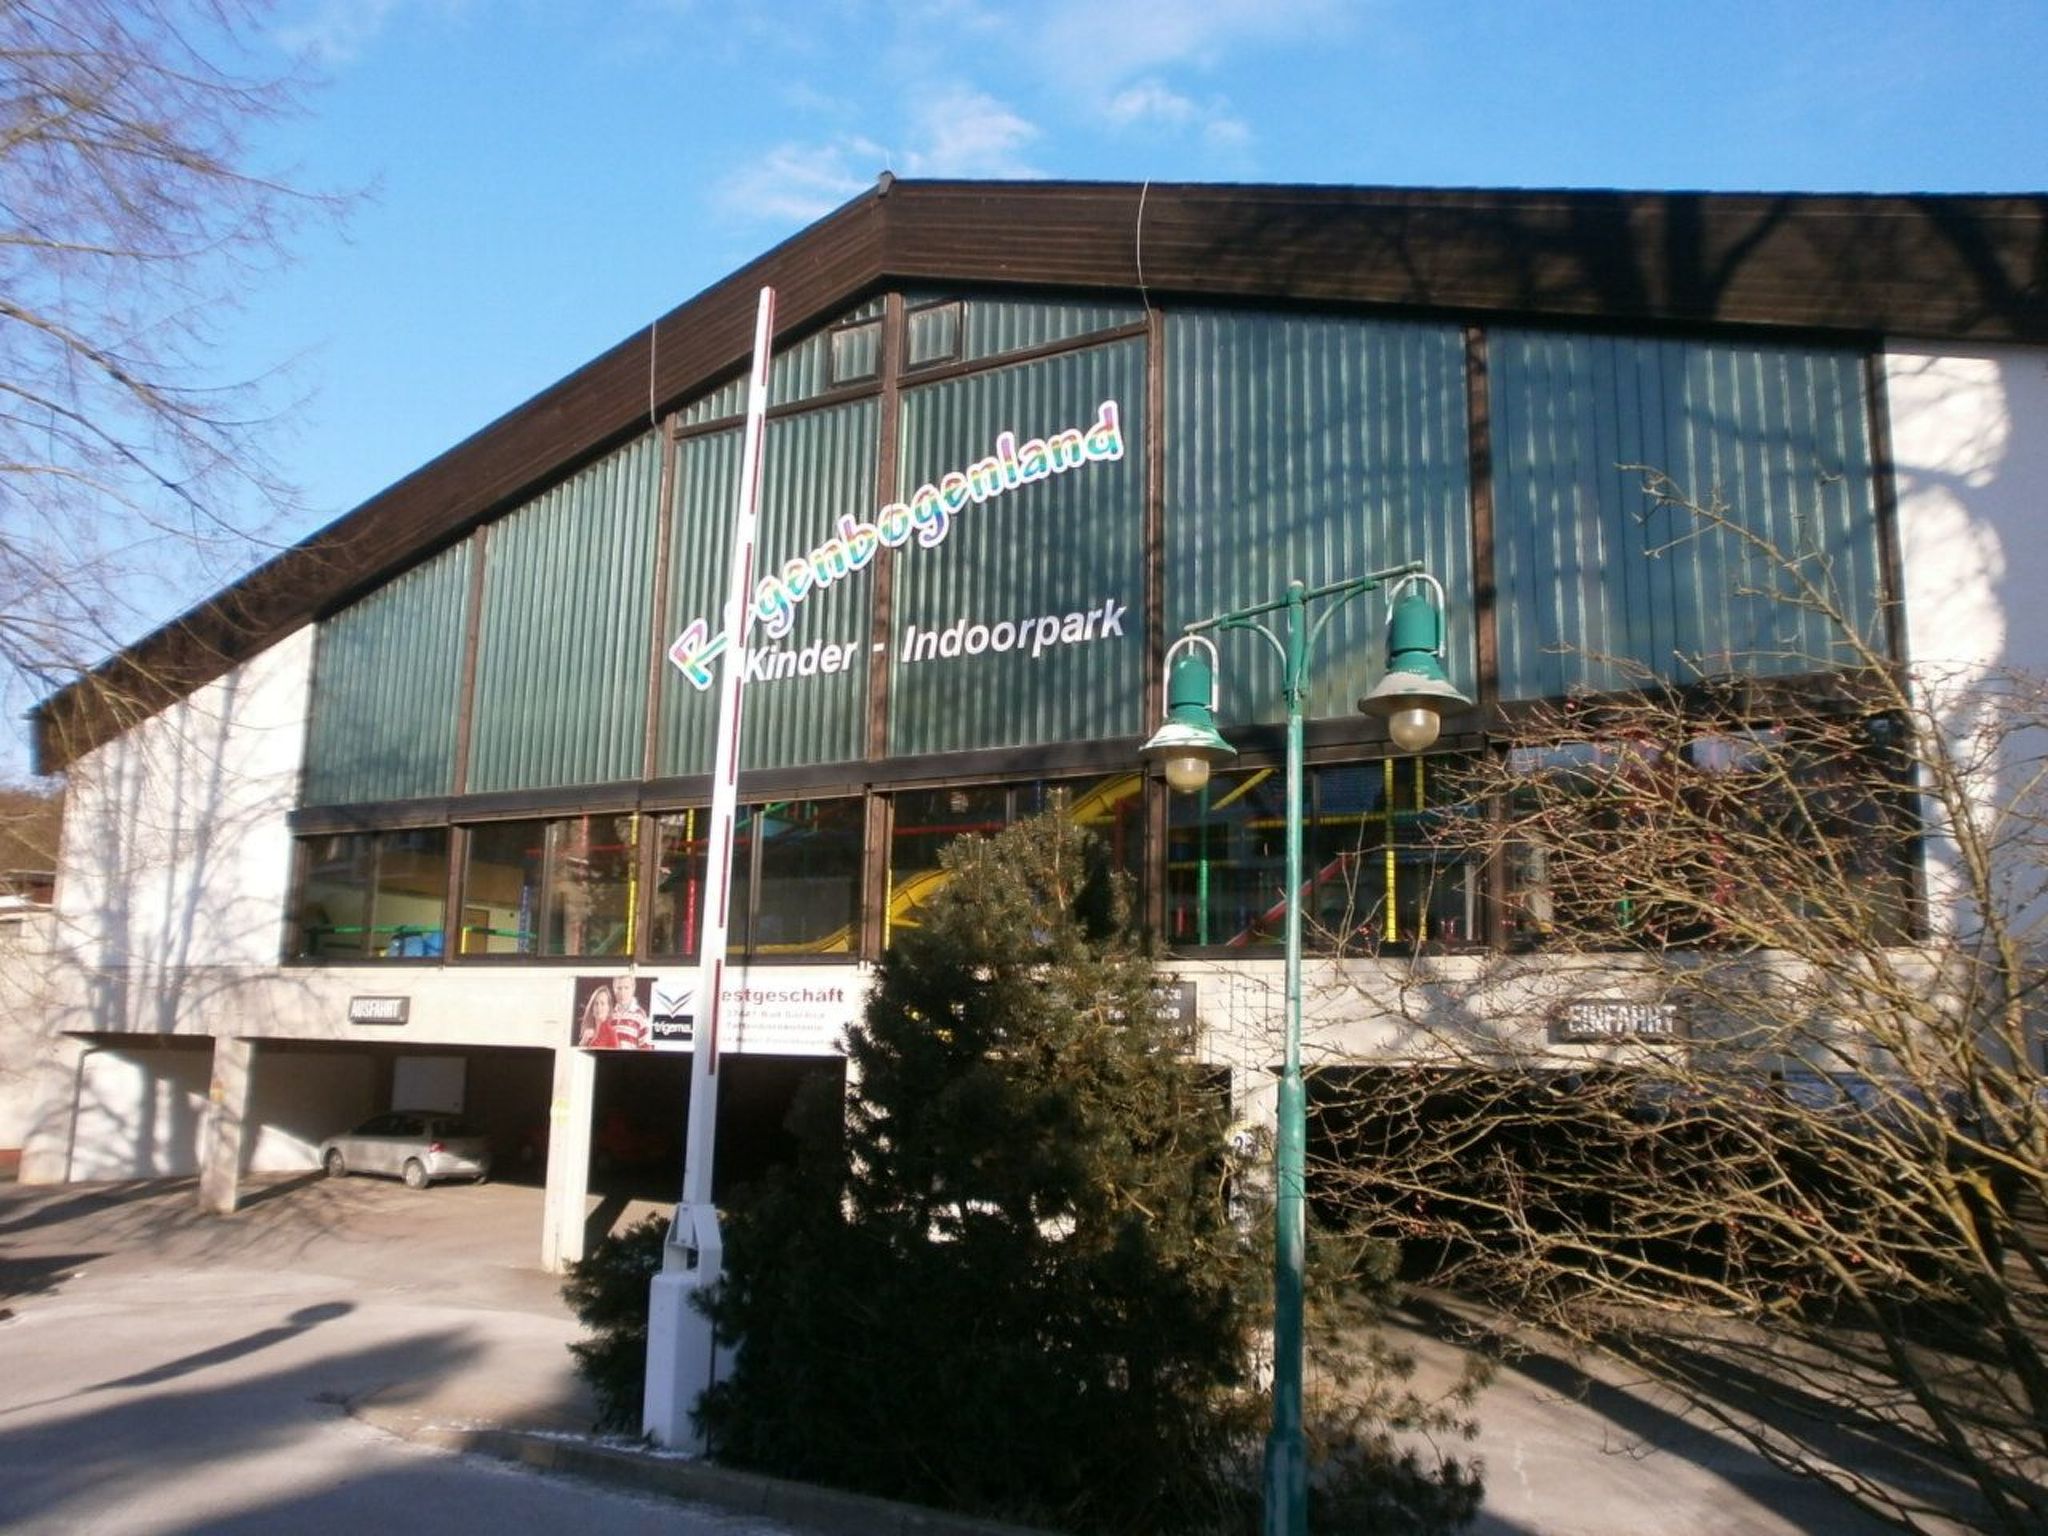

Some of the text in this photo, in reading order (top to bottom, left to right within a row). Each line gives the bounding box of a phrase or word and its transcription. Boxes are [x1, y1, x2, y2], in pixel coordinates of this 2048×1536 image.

[668, 401, 1123, 692] Rgenbogenland
[743, 637, 858, 684] Kinder
[901, 598, 1128, 664] Indoorpark
[1568, 1004, 1677, 1033] EINFAHRT
